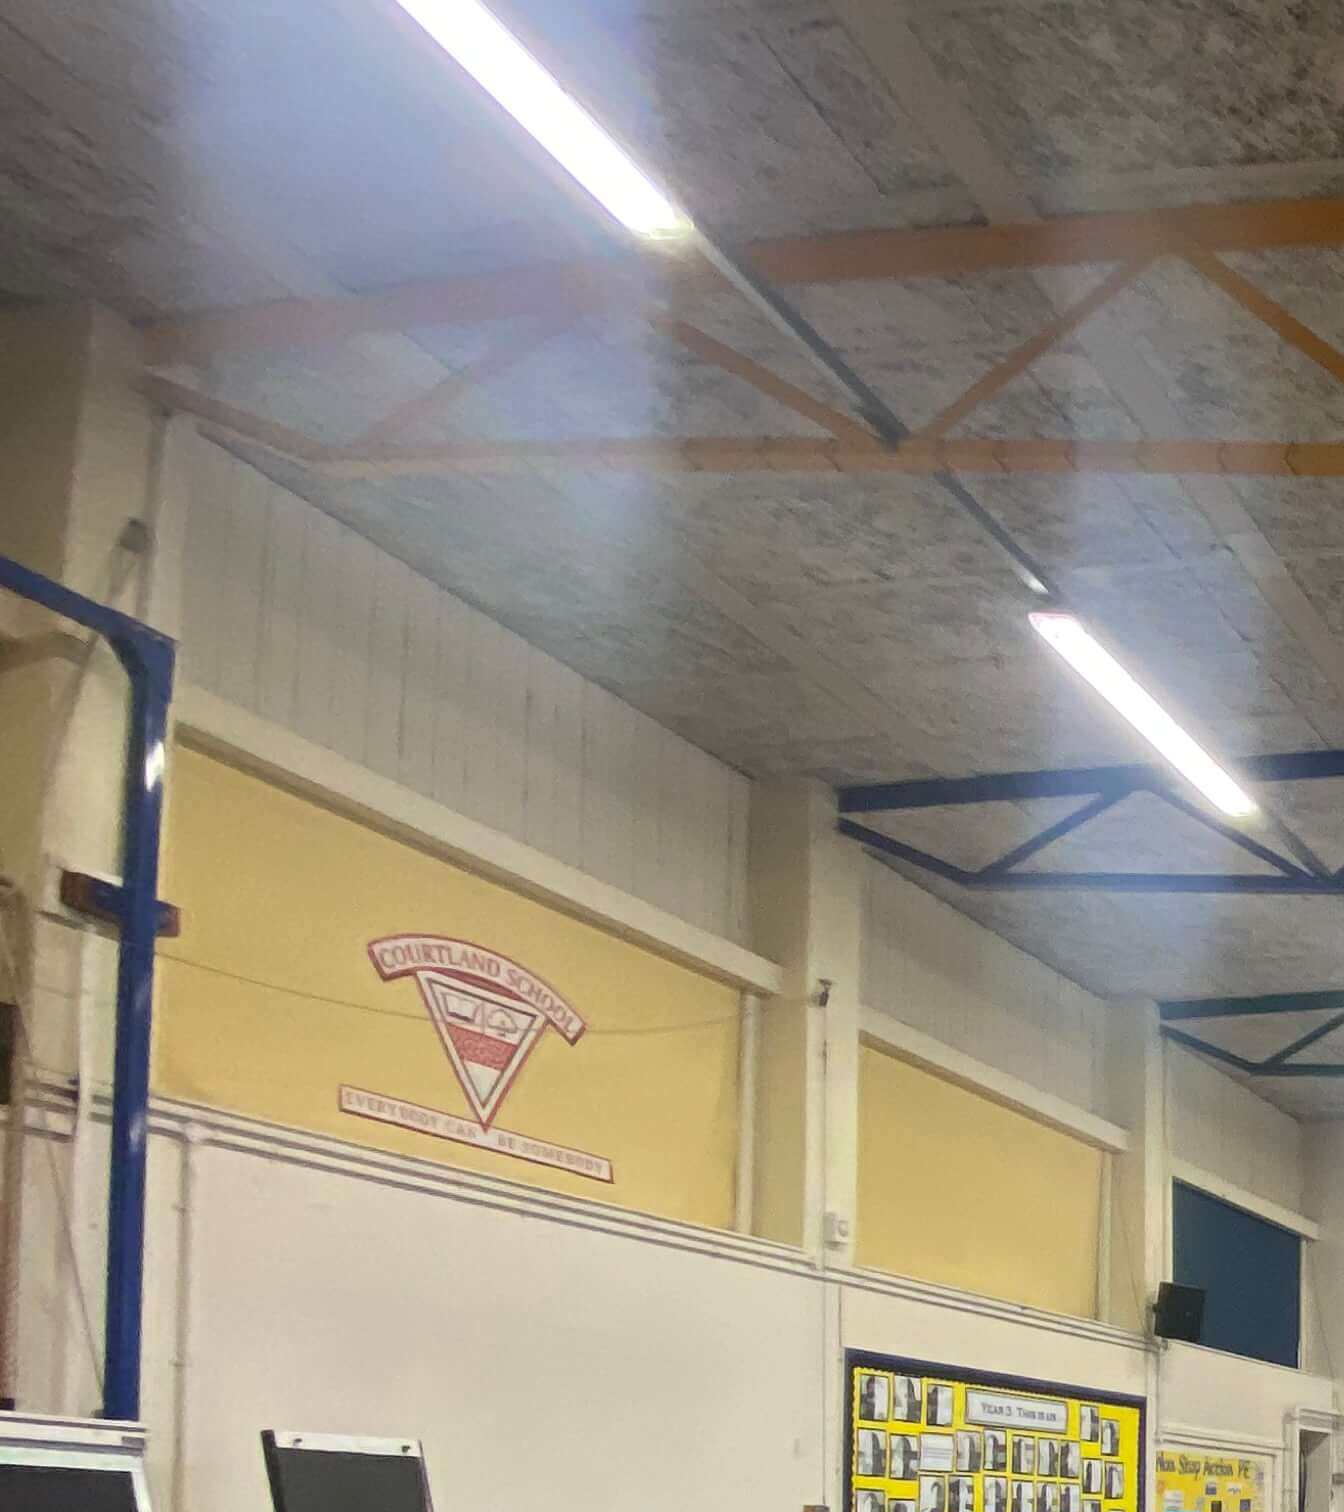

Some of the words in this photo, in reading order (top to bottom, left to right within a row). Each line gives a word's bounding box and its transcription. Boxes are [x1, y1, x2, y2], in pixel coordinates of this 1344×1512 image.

[378, 943, 501, 978] COURTLAND
[506, 968, 575, 1033] SCHOOL
[496, 1133, 516, 1151] BE
[521, 1142, 604, 1175] SOMEBODY
[1005, 1405, 1012, 1417] 3
[1177, 1454, 1201, 1480] Stop
[1203, 1455, 1234, 1476] Action
[1238, 1459, 1251, 1480] PE
